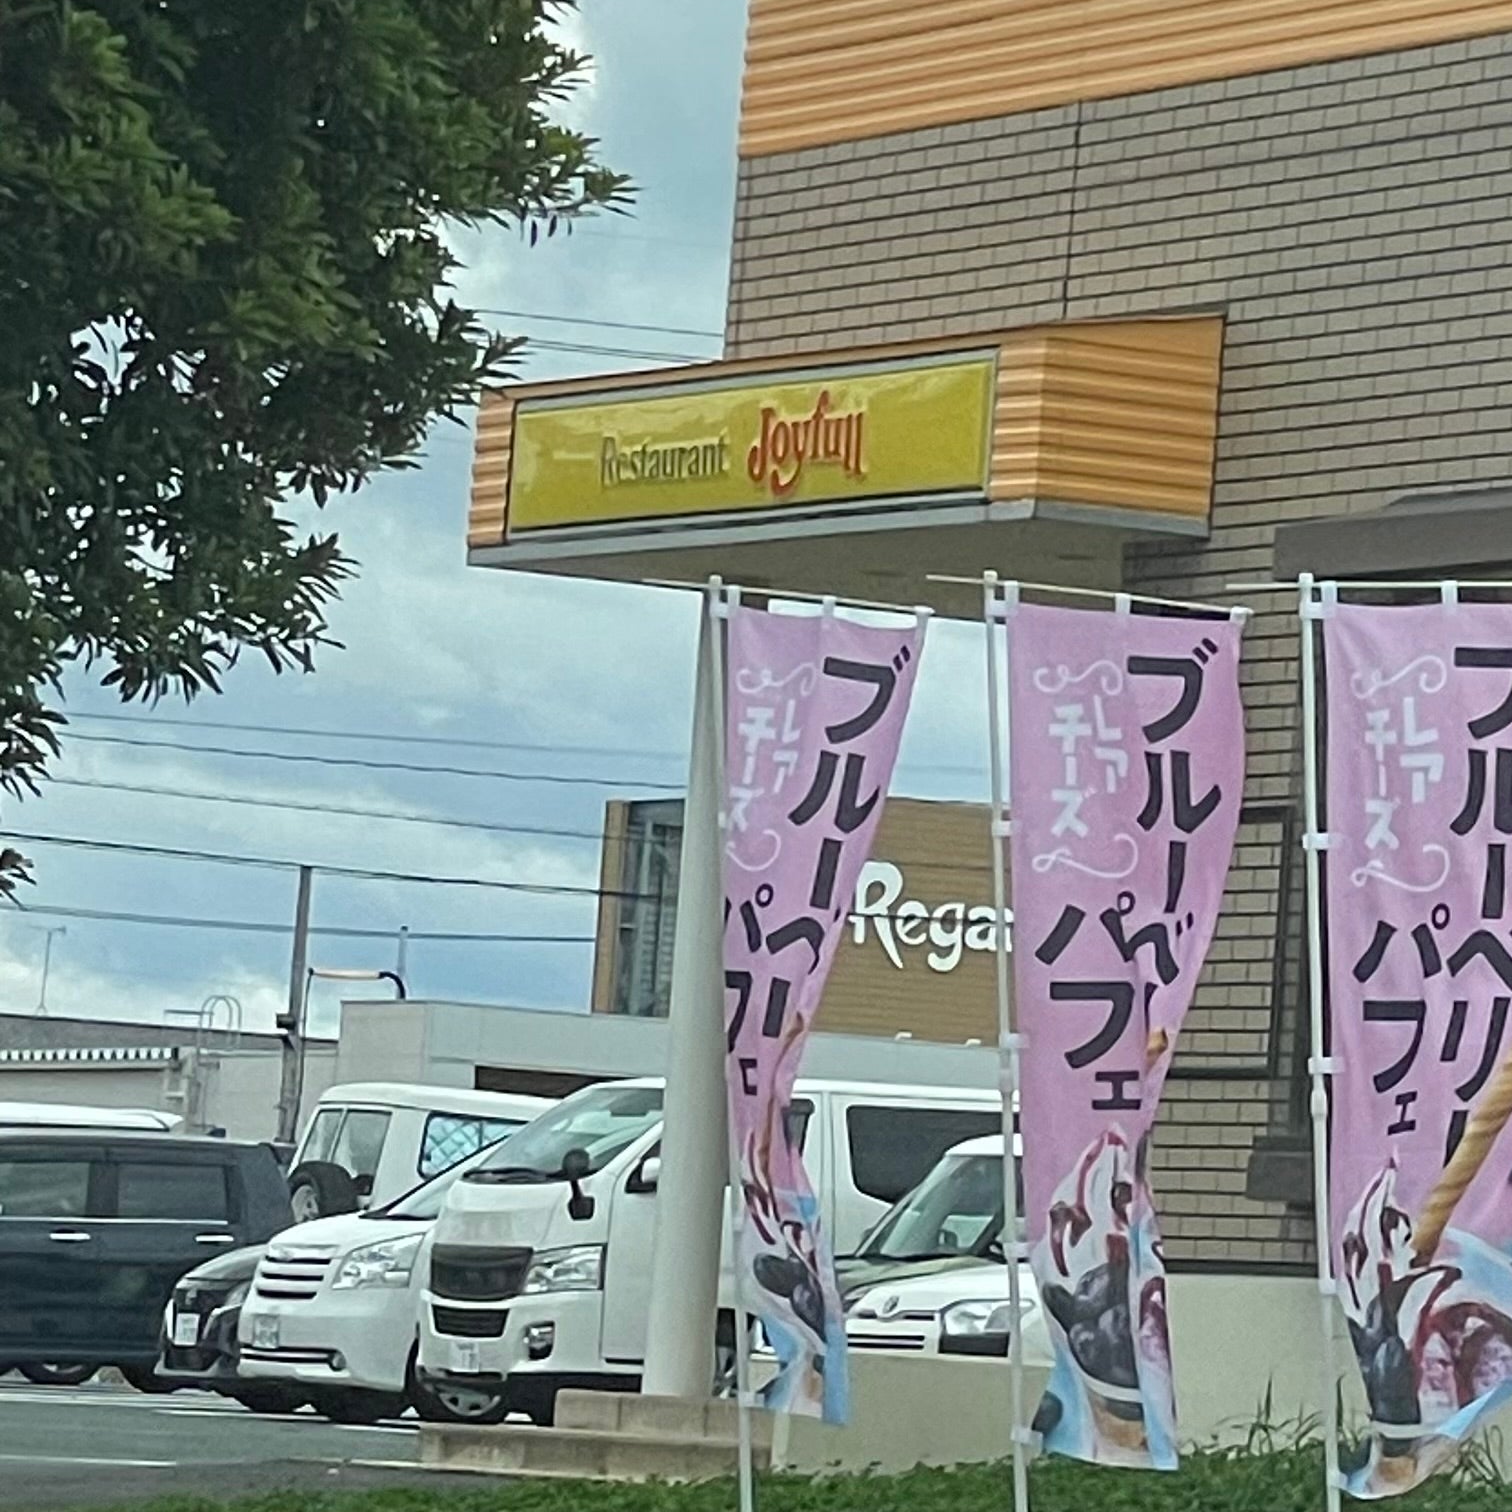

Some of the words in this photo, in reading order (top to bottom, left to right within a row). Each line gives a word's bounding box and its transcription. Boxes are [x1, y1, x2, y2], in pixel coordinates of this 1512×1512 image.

[601, 436, 727, 485] Restaurant
[747, 390, 864, 496] Joyfull
[1048, 703, 1097, 838] チーズ
[1093, 693, 1129, 794] レア
[1364, 708, 1400, 850] チーズ
[1400, 696, 1445, 804] レア
[1034, 890, 1142, 1110] パフェ
[1352, 903, 1450, 1135] パフェ
